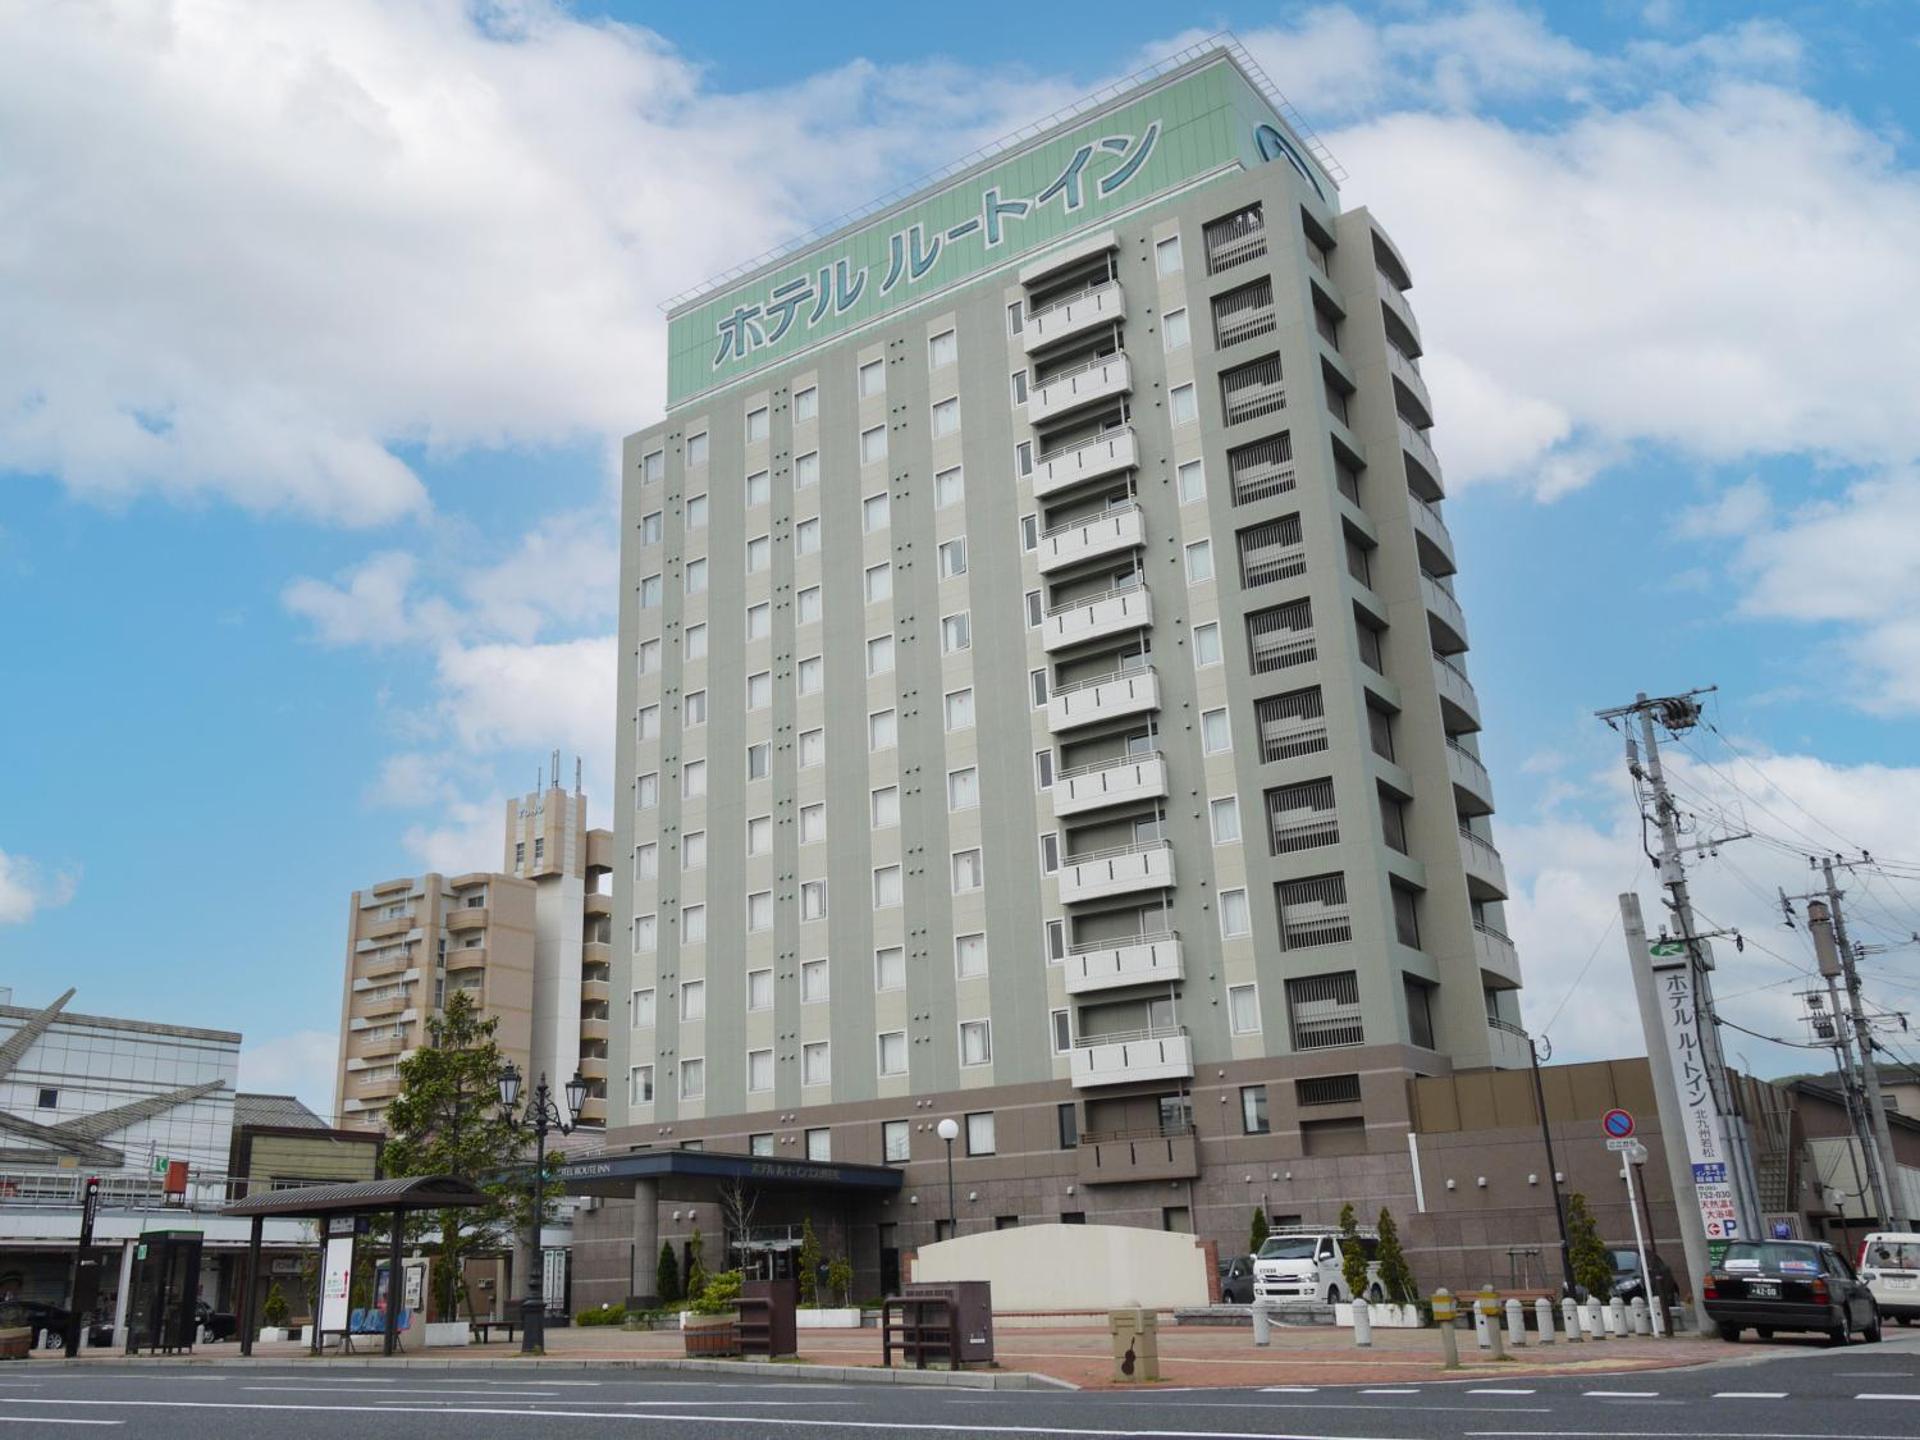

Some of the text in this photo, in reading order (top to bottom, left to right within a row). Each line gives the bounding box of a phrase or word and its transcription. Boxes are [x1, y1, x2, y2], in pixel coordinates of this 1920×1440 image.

[713, 119, 1162, 371] ホテル ルートイン
[1666, 974, 1693, 1026] ホテル
[1678, 1032, 1707, 1107] ルートイン
[1694, 1109, 1715, 1158] 北九州若松
[1723, 1220, 1737, 1236] P
